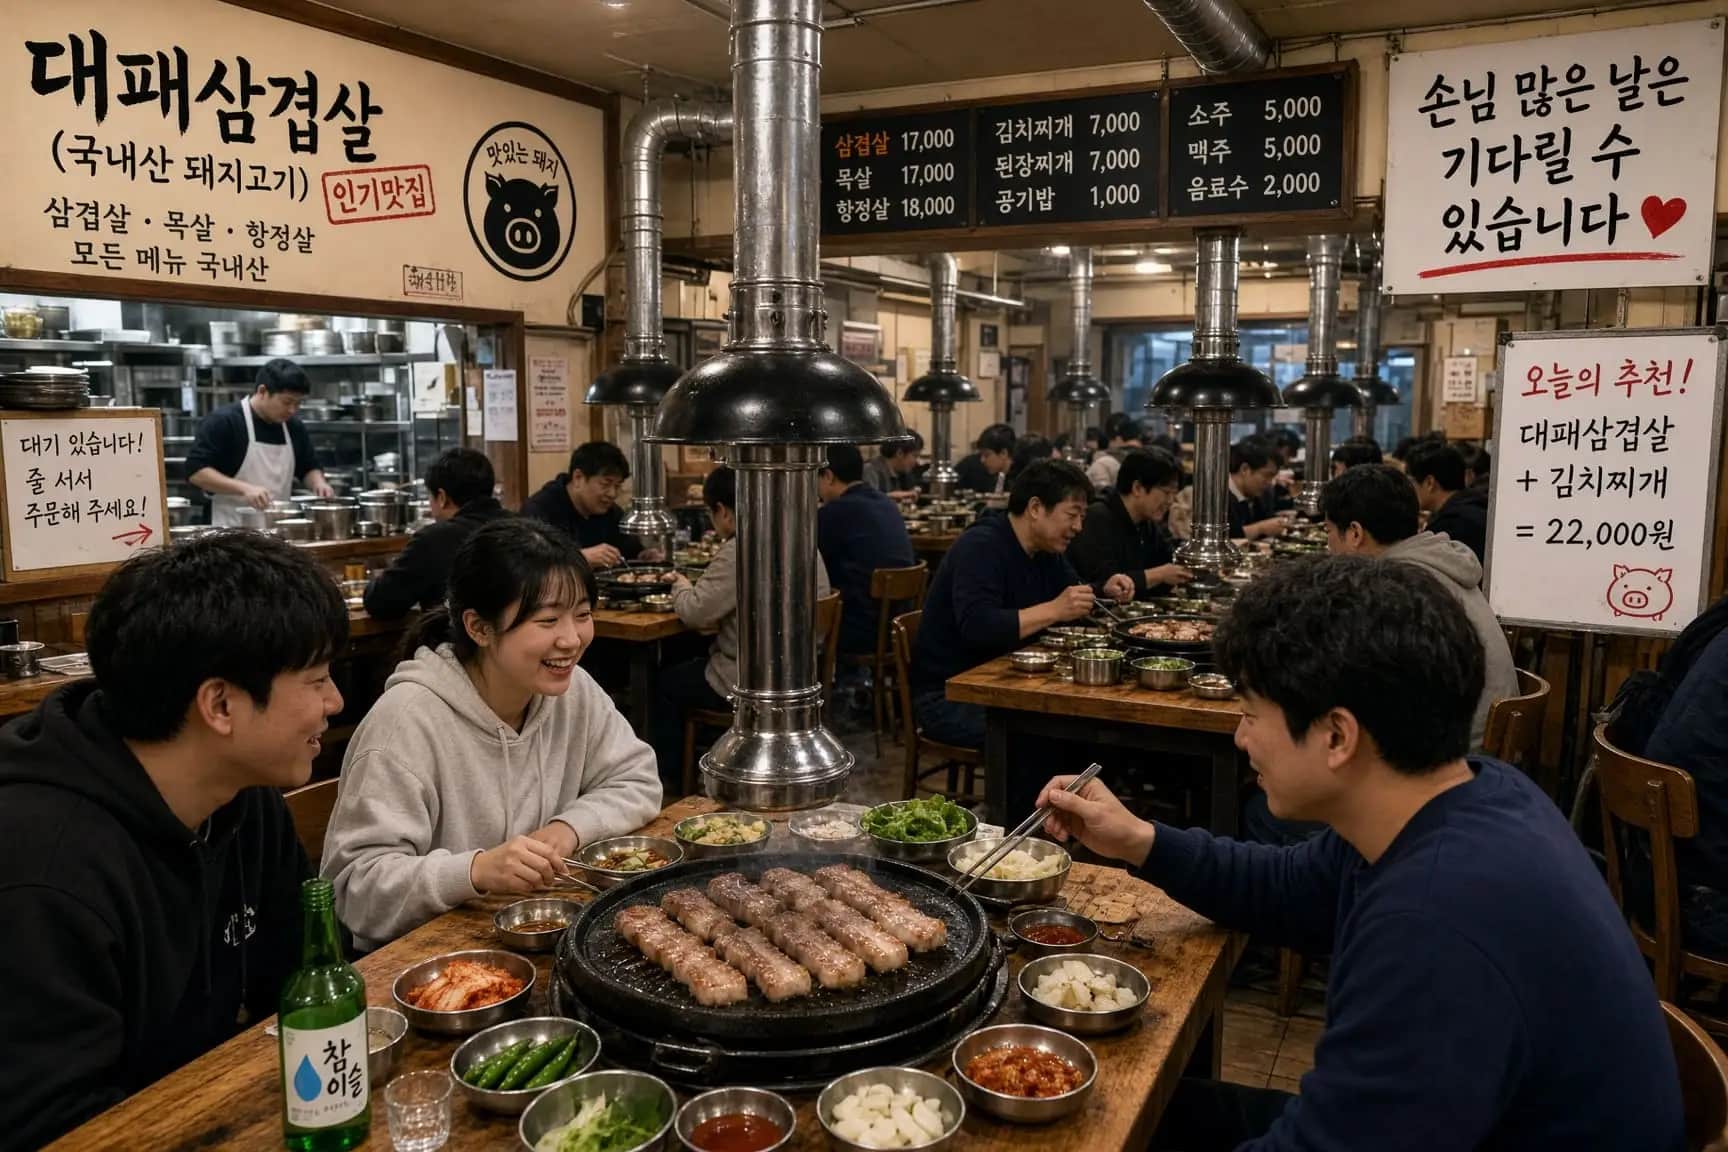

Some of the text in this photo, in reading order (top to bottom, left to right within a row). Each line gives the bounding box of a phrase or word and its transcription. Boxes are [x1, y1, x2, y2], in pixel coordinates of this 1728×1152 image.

[24, 28, 384, 163] 대패삼겹살
[1418, 55, 1690, 129] 손님 많은 날은
[995, 111, 1140, 145] 김치찌개 7,000
[1187, 95, 1322, 127] 소주 5,000
[486, 140, 559, 180] 맛있는 돼지
[834, 128, 955, 160] 삼겹살 17,000
[1188, 134, 1321, 165] 맥주 5,000
[1442, 123, 1641, 188] 기다릴 수
[51, 129, 309, 202] (국내산 돼지고기)
[835, 162, 955, 191] 목살 17,000
[995, 148, 1140, 179] 된장찌개 7,000
[333, 174, 426, 214] 인기맛집
[995, 183, 1140, 214] 공기밥 1,000
[1186, 172, 1320, 202] 음료수 2,000
[43, 196, 131, 235] 삼겹살
[163, 210, 216, 243] 목살
[245, 220, 315, 254] 항정살
[836, 195, 955, 223] 항정살 18,000
[1442, 191, 1630, 255] 있습니다
[70, 240, 269, 283] 모든 메뉴 국내산
[1521, 358, 1694, 400] 오늘의 추천!
[20, 431, 143, 457] 대기 있습니다!
[1519, 415, 1675, 453] 대패삼겹살
[25, 467, 92, 495] 줄 서서
[1550, 463, 1668, 499] 김치찌개
[24, 496, 146, 529] 주문해 주세요!
[1545, 518, 1675, 551] 22,000원
